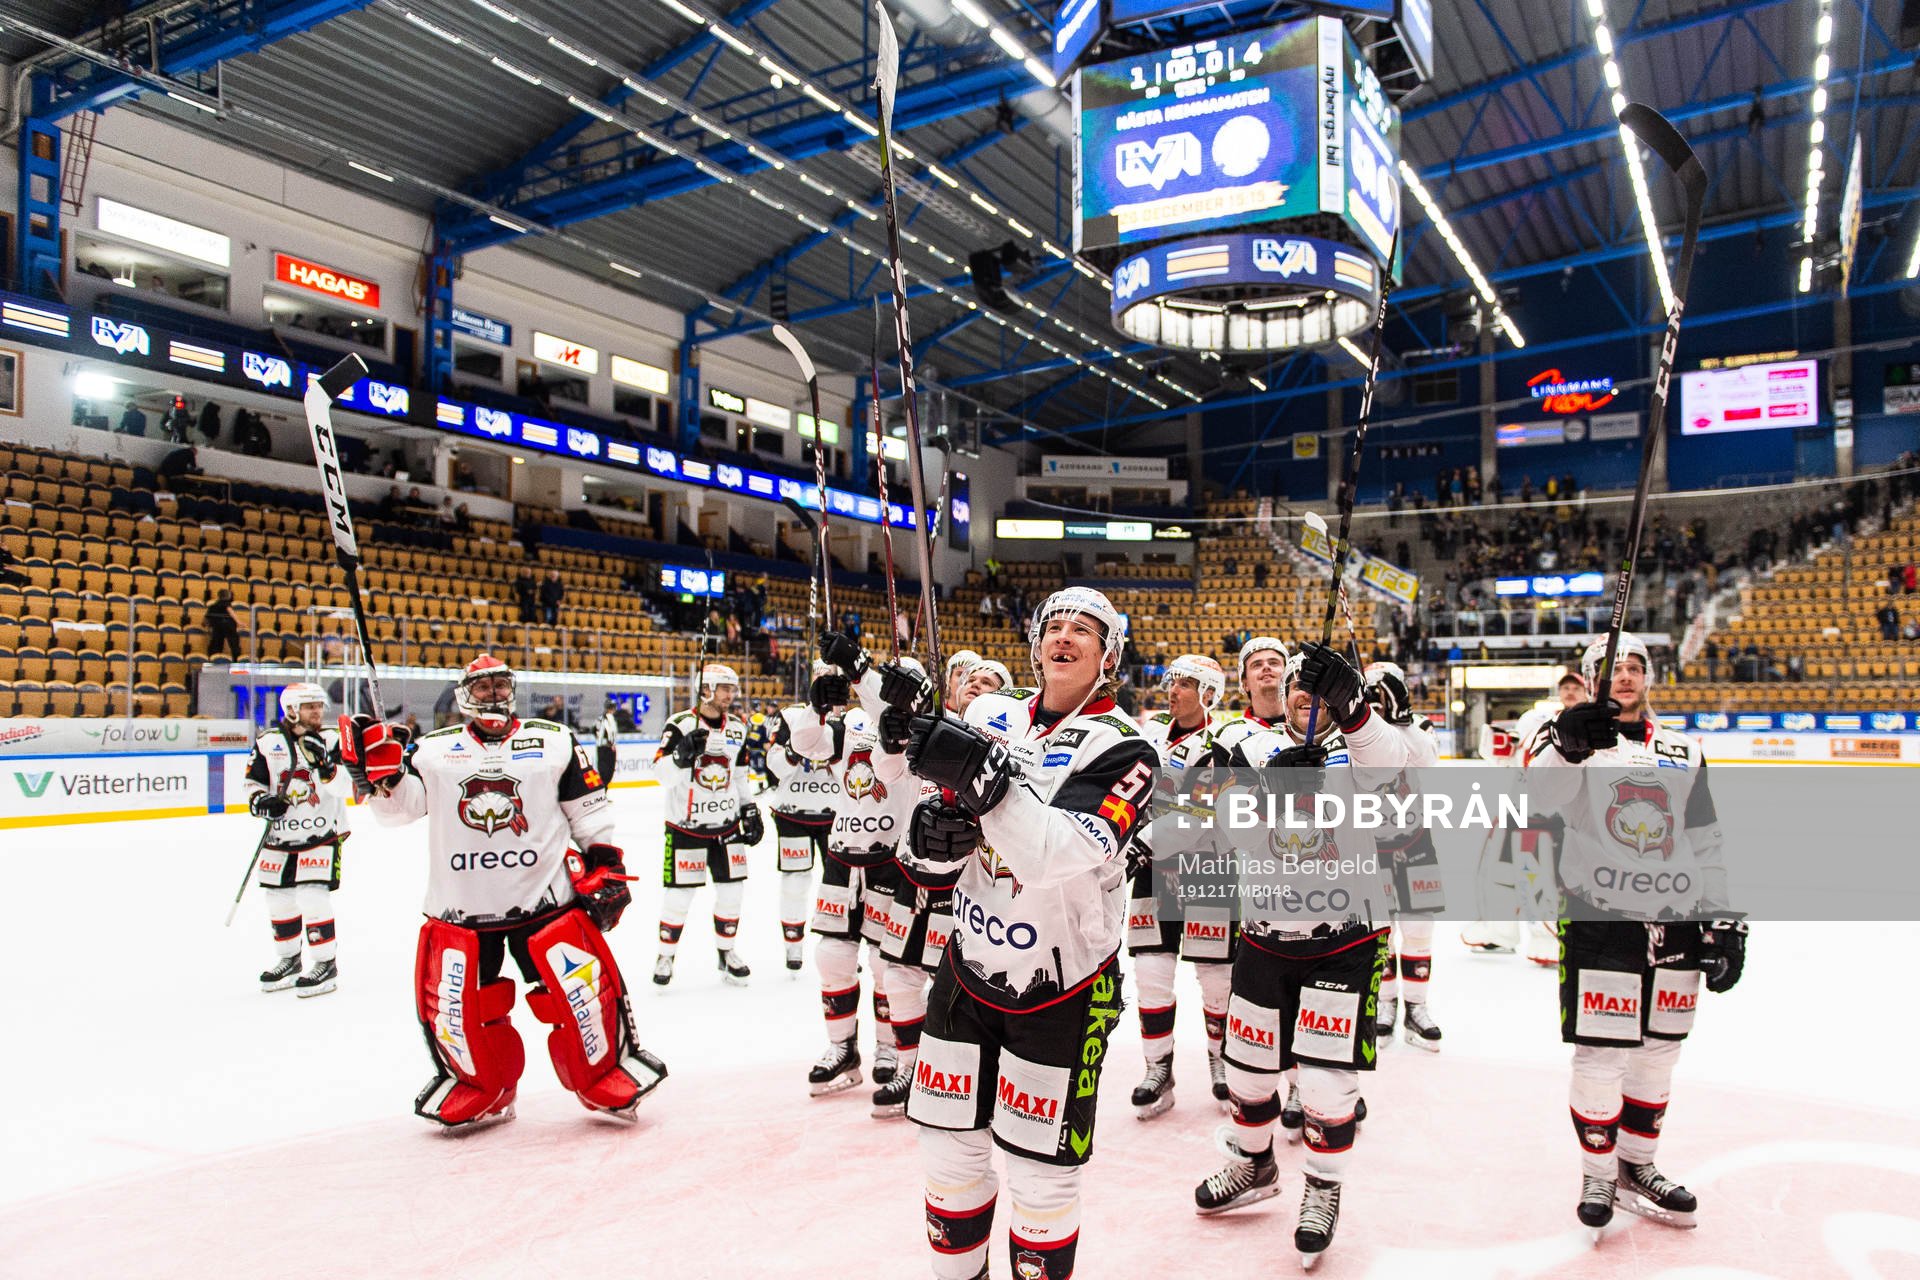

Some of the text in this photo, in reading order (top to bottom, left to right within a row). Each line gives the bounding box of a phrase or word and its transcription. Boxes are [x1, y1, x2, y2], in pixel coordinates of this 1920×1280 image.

[1243, 41, 1263, 65] 4
[1320, 66, 1342, 167] nybergs bil
[1655, 296, 1685, 403] CCM
[315, 424, 351, 535] CCM
[1366, 558, 1414, 597] TIFO
[1611, 569, 1630, 629] RIBCOR
[1013, 746, 1034, 756] CCM
[60, 773, 188, 796] Vätterhem
[789, 781, 841, 794] areco
[691, 798, 735, 814] areco
[835, 815, 895, 833] areco
[299, 857, 330, 868] MAXI
[450, 849, 539, 872] areco
[663, 833, 673, 883] akea
[782, 848, 809, 857] MAXI
[678, 861, 705, 870] MAXI
[873, 884, 895, 894] CCM
[1594, 866, 1692, 894] areco
[816, 898, 845, 915] MAXI
[1252, 887, 1351, 913] areco
[953, 887, 1038, 951] areco
[1186, 922, 1227, 938] MAXI
[1314, 980, 1349, 991] CCM
[1583, 991, 1637, 1013] MAXI
[567, 984, 600, 1058] bravida
[1229, 1014, 1274, 1046] MAXI
[1298, 1008, 1351, 1034] MAXI
[1076, 973, 1120, 1099] akea
[1234, 1034, 1274, 1051] STORMARKNAD
[1305, 1028, 1349, 1039] STORMARKNAD
[917, 1060, 972, 1094] MAXI
[921, 1087, 970, 1101] STORMARKNAD
[998, 1075, 1058, 1119] MAXI
[1003, 1103, 1054, 1126] STORMARKNAD
[1020, 1225, 1049, 1235] CCM
